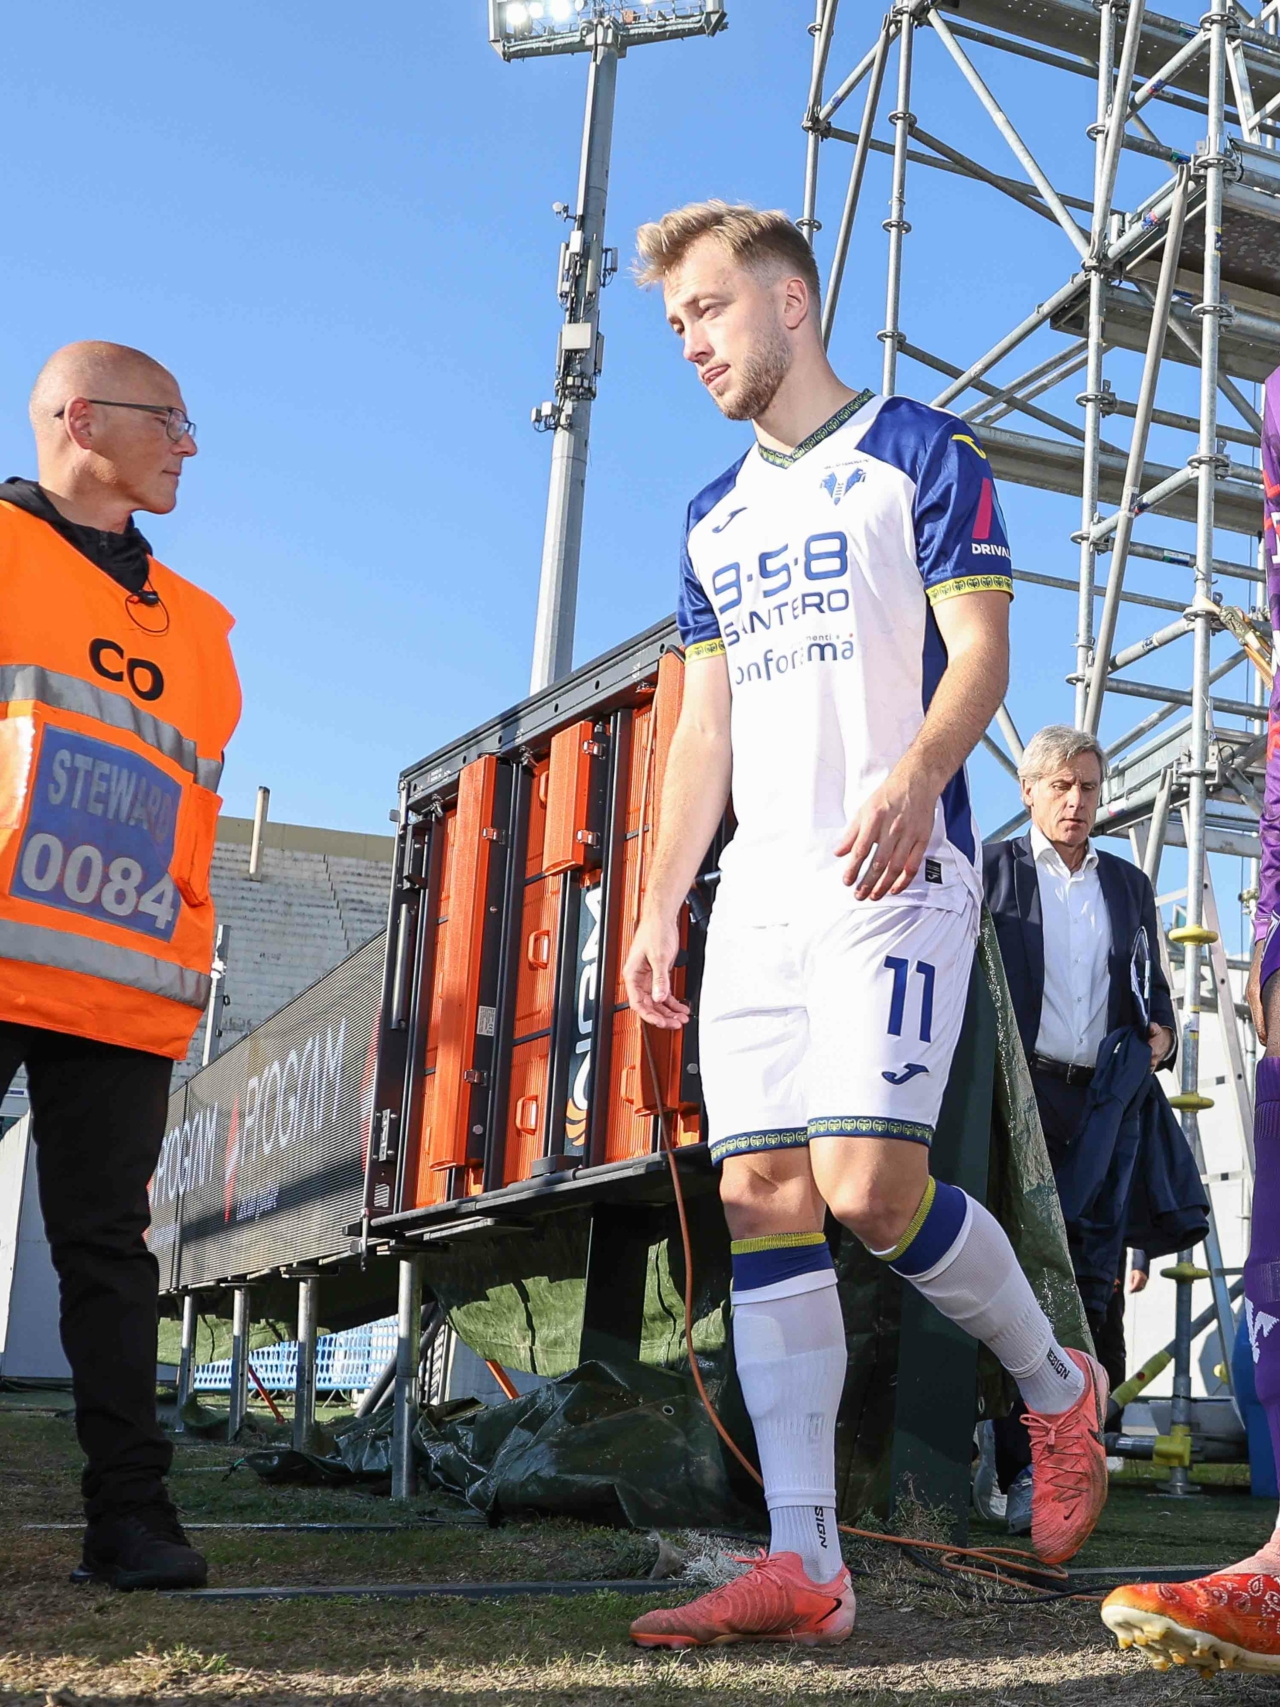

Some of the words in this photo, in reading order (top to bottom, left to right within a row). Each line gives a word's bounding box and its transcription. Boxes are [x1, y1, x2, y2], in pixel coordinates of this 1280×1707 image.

[88, 637, 164, 701] CO
[21, 833, 174, 930] 0084
[884, 955, 936, 1043] 11
